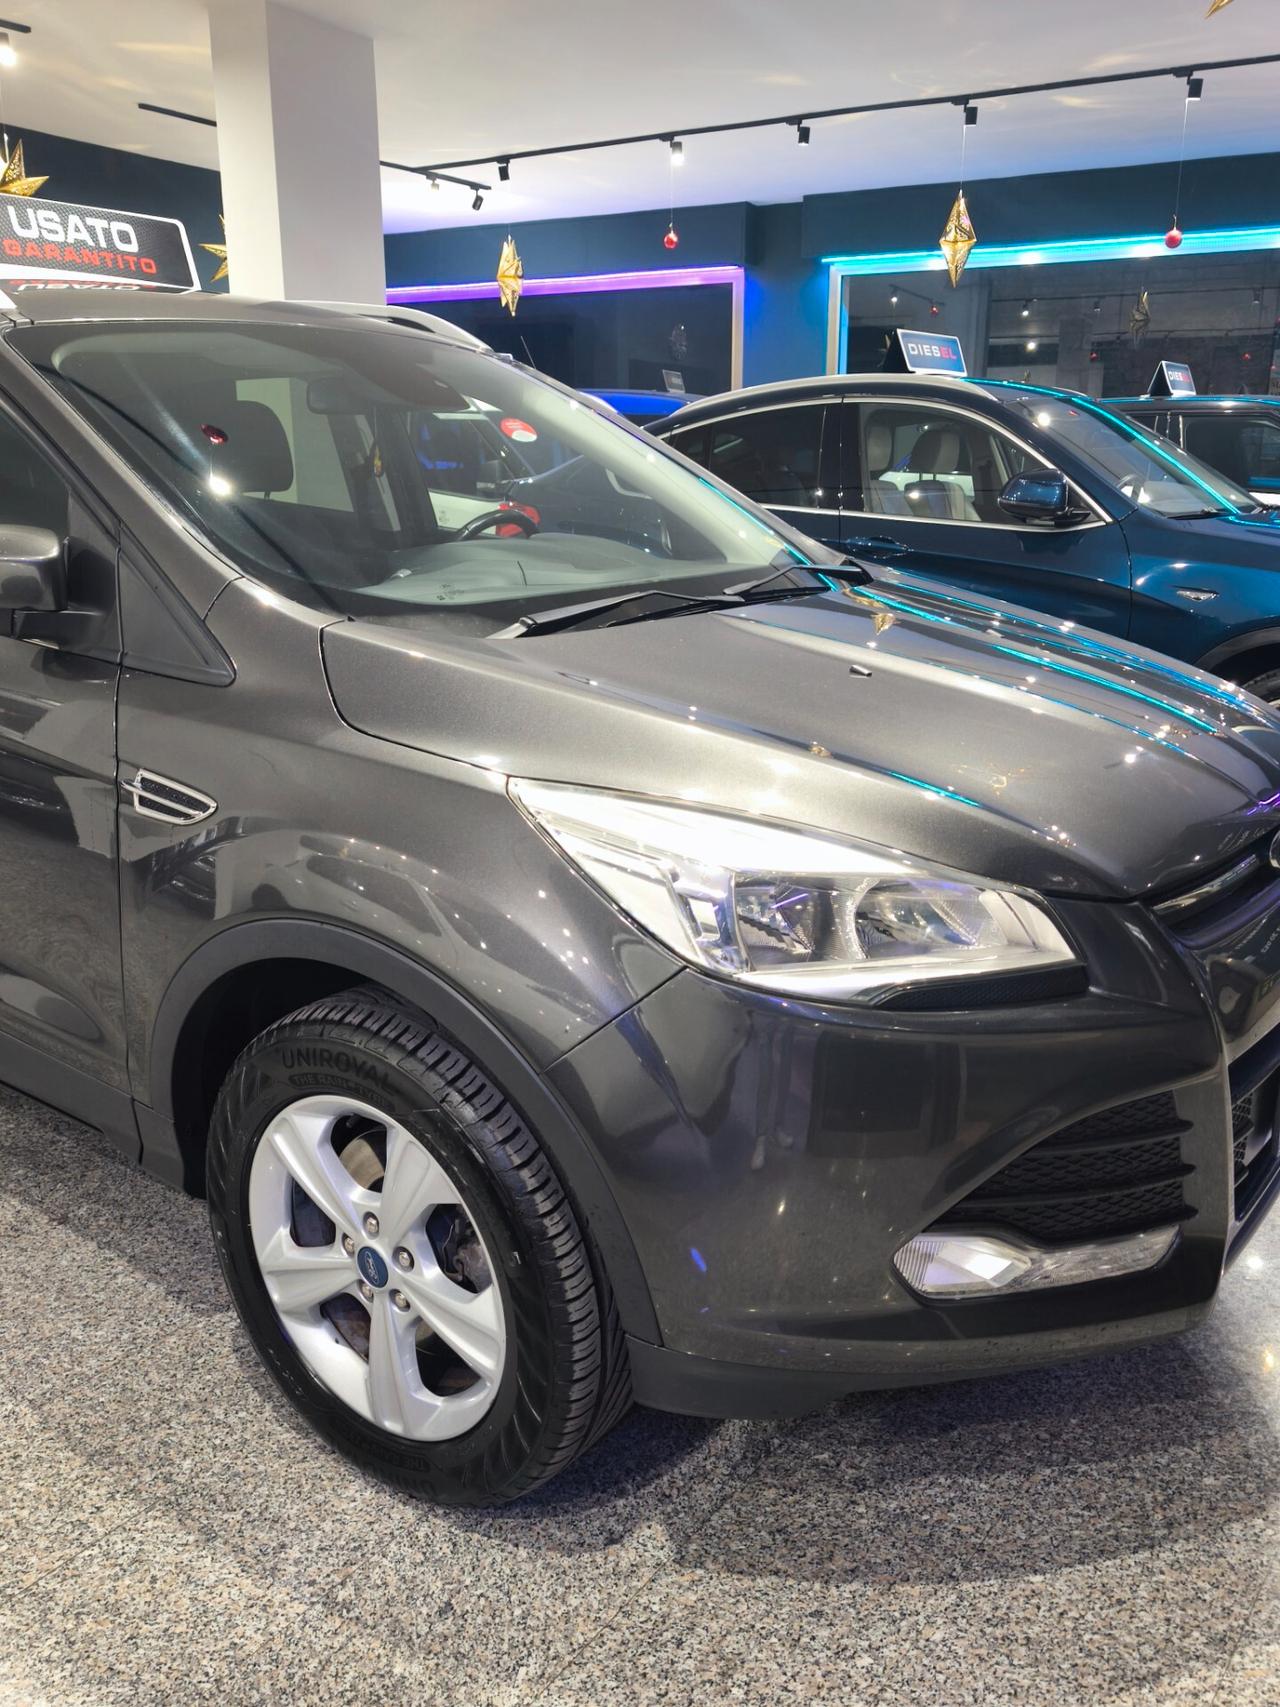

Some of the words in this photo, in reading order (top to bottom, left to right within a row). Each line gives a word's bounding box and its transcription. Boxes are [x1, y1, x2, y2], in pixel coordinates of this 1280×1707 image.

[7, 205, 139, 252] USATO
[3, 239, 157, 274] GARANTITO
[908, 343, 957, 359] DIESEL
[281, 1047, 396, 1097] UNIROYAL
